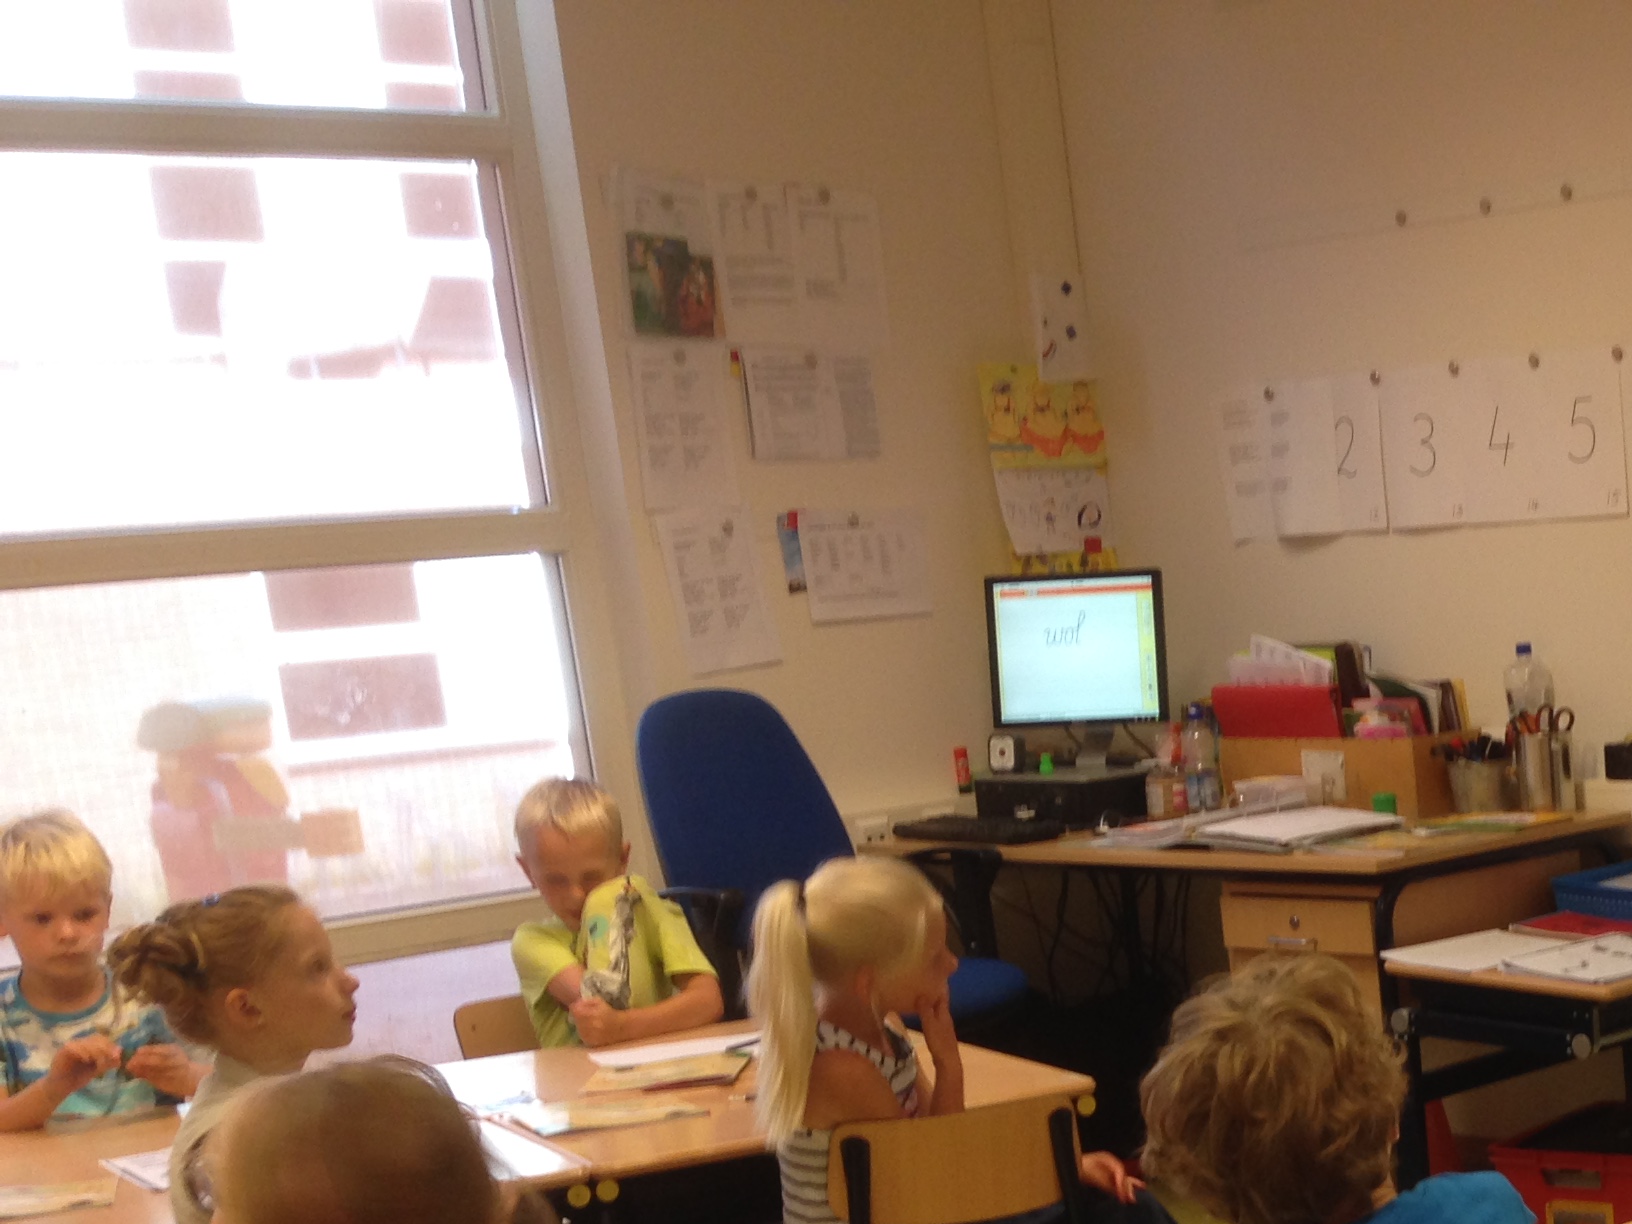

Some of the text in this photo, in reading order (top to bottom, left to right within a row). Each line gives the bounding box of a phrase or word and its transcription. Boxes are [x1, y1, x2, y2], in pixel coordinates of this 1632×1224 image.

[1334, 415, 1358, 480] 2
[1409, 412, 1437, 478] 3
[1488, 405, 1515, 467] 4
[1567, 395, 1596, 464] 5
[1044, 609, 1087, 648] wol
